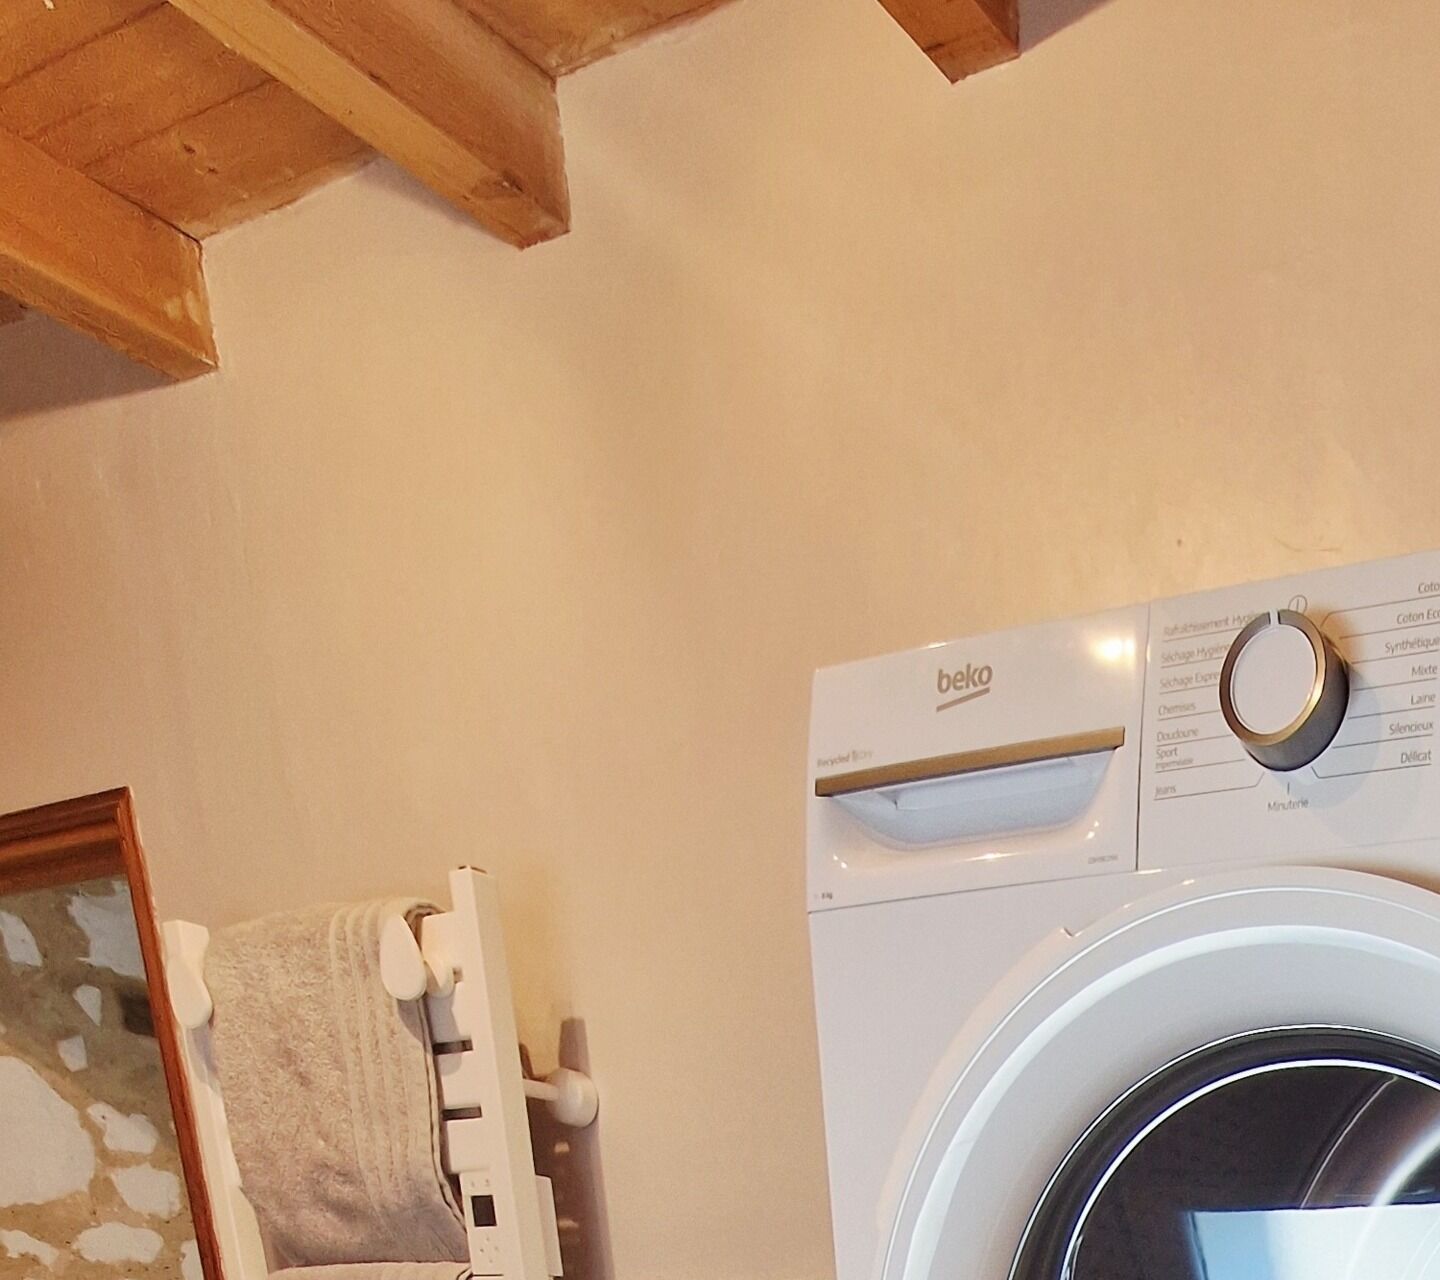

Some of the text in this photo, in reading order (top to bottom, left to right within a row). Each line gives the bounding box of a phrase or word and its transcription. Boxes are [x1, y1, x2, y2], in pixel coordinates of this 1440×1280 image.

[1397, 612, 1425, 625] Coton
[1411, 664, 1438, 676] Mixte
[937, 664, 993, 694] beko
[1410, 693, 1436, 706] Laine
[1156, 727, 1198, 742] Doudoune
[1389, 720, 1434, 735] Silencieux
[1156, 746, 1178, 760] Sport
[1401, 749, 1432, 764] Délicat
[1267, 799, 1309, 812] Minuterie
